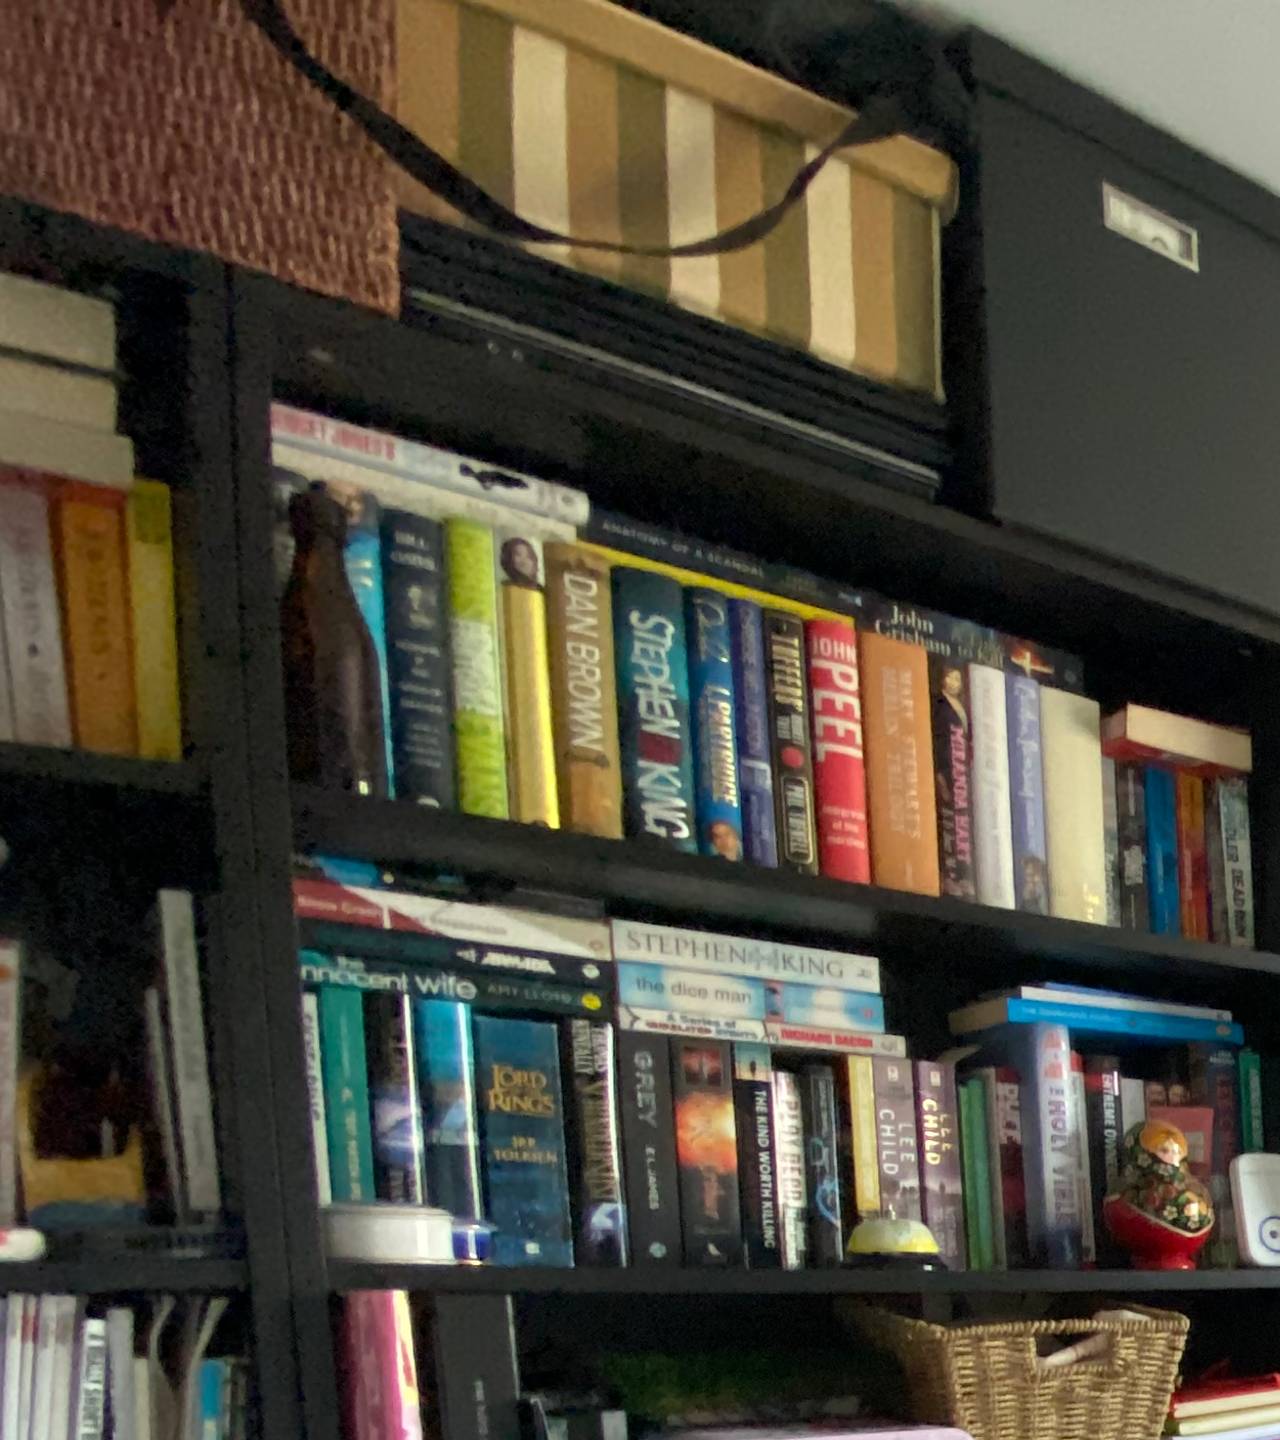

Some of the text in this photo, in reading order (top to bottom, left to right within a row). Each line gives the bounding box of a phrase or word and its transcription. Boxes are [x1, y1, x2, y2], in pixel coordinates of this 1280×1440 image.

[890, 605, 934, 635] John
[563, 573, 605, 751] DAN BROWN
[813, 637, 856, 660] JOHN
[628, 609, 690, 840] STEPHEN KING
[811, 658, 863, 763] PEEL
[950, 724, 972, 865] MIRANDA HART
[1231, 868, 1245, 909] DEAD
[626, 930, 845, 980] STEPHEN KING
[301, 966, 408, 993] nnocent
[414, 974, 477, 1001] wife
[635, 976, 752, 1005] the dice man
[490, 1063, 548, 1092] LORD
[633, 1051, 657, 1128] GREY
[488, 1089, 555, 1117] RINGS
[1047, 1100, 1070, 1154] HOLY
[879, 1108, 899, 1176] CHILD
[898, 1123, 915, 1163] LEE
[922, 1098, 942, 1165] CHILD
[940, 1113, 954, 1152] LEE
[755, 1090, 776, 1249] THE KIND WORTH KILLING
